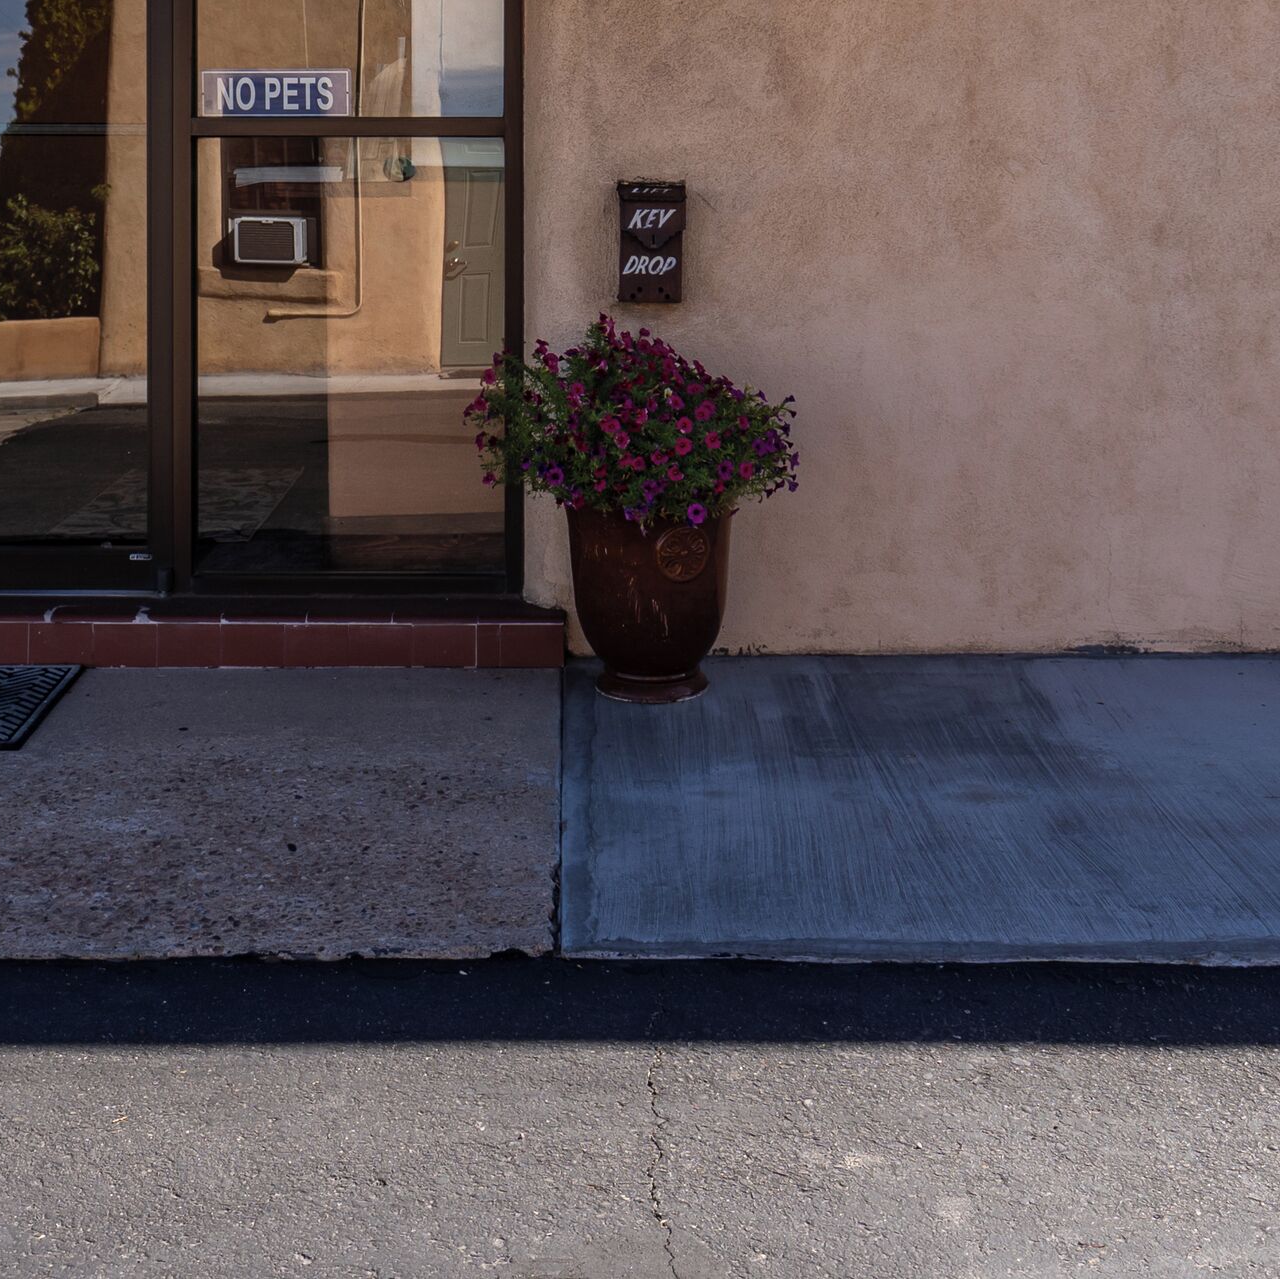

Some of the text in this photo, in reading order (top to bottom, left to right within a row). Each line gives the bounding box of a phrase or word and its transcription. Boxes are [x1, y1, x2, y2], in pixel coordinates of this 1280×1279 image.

[216, 76, 334, 111] NO PETS
[627, 208, 677, 230] KEY
[622, 255, 677, 275] DROP
